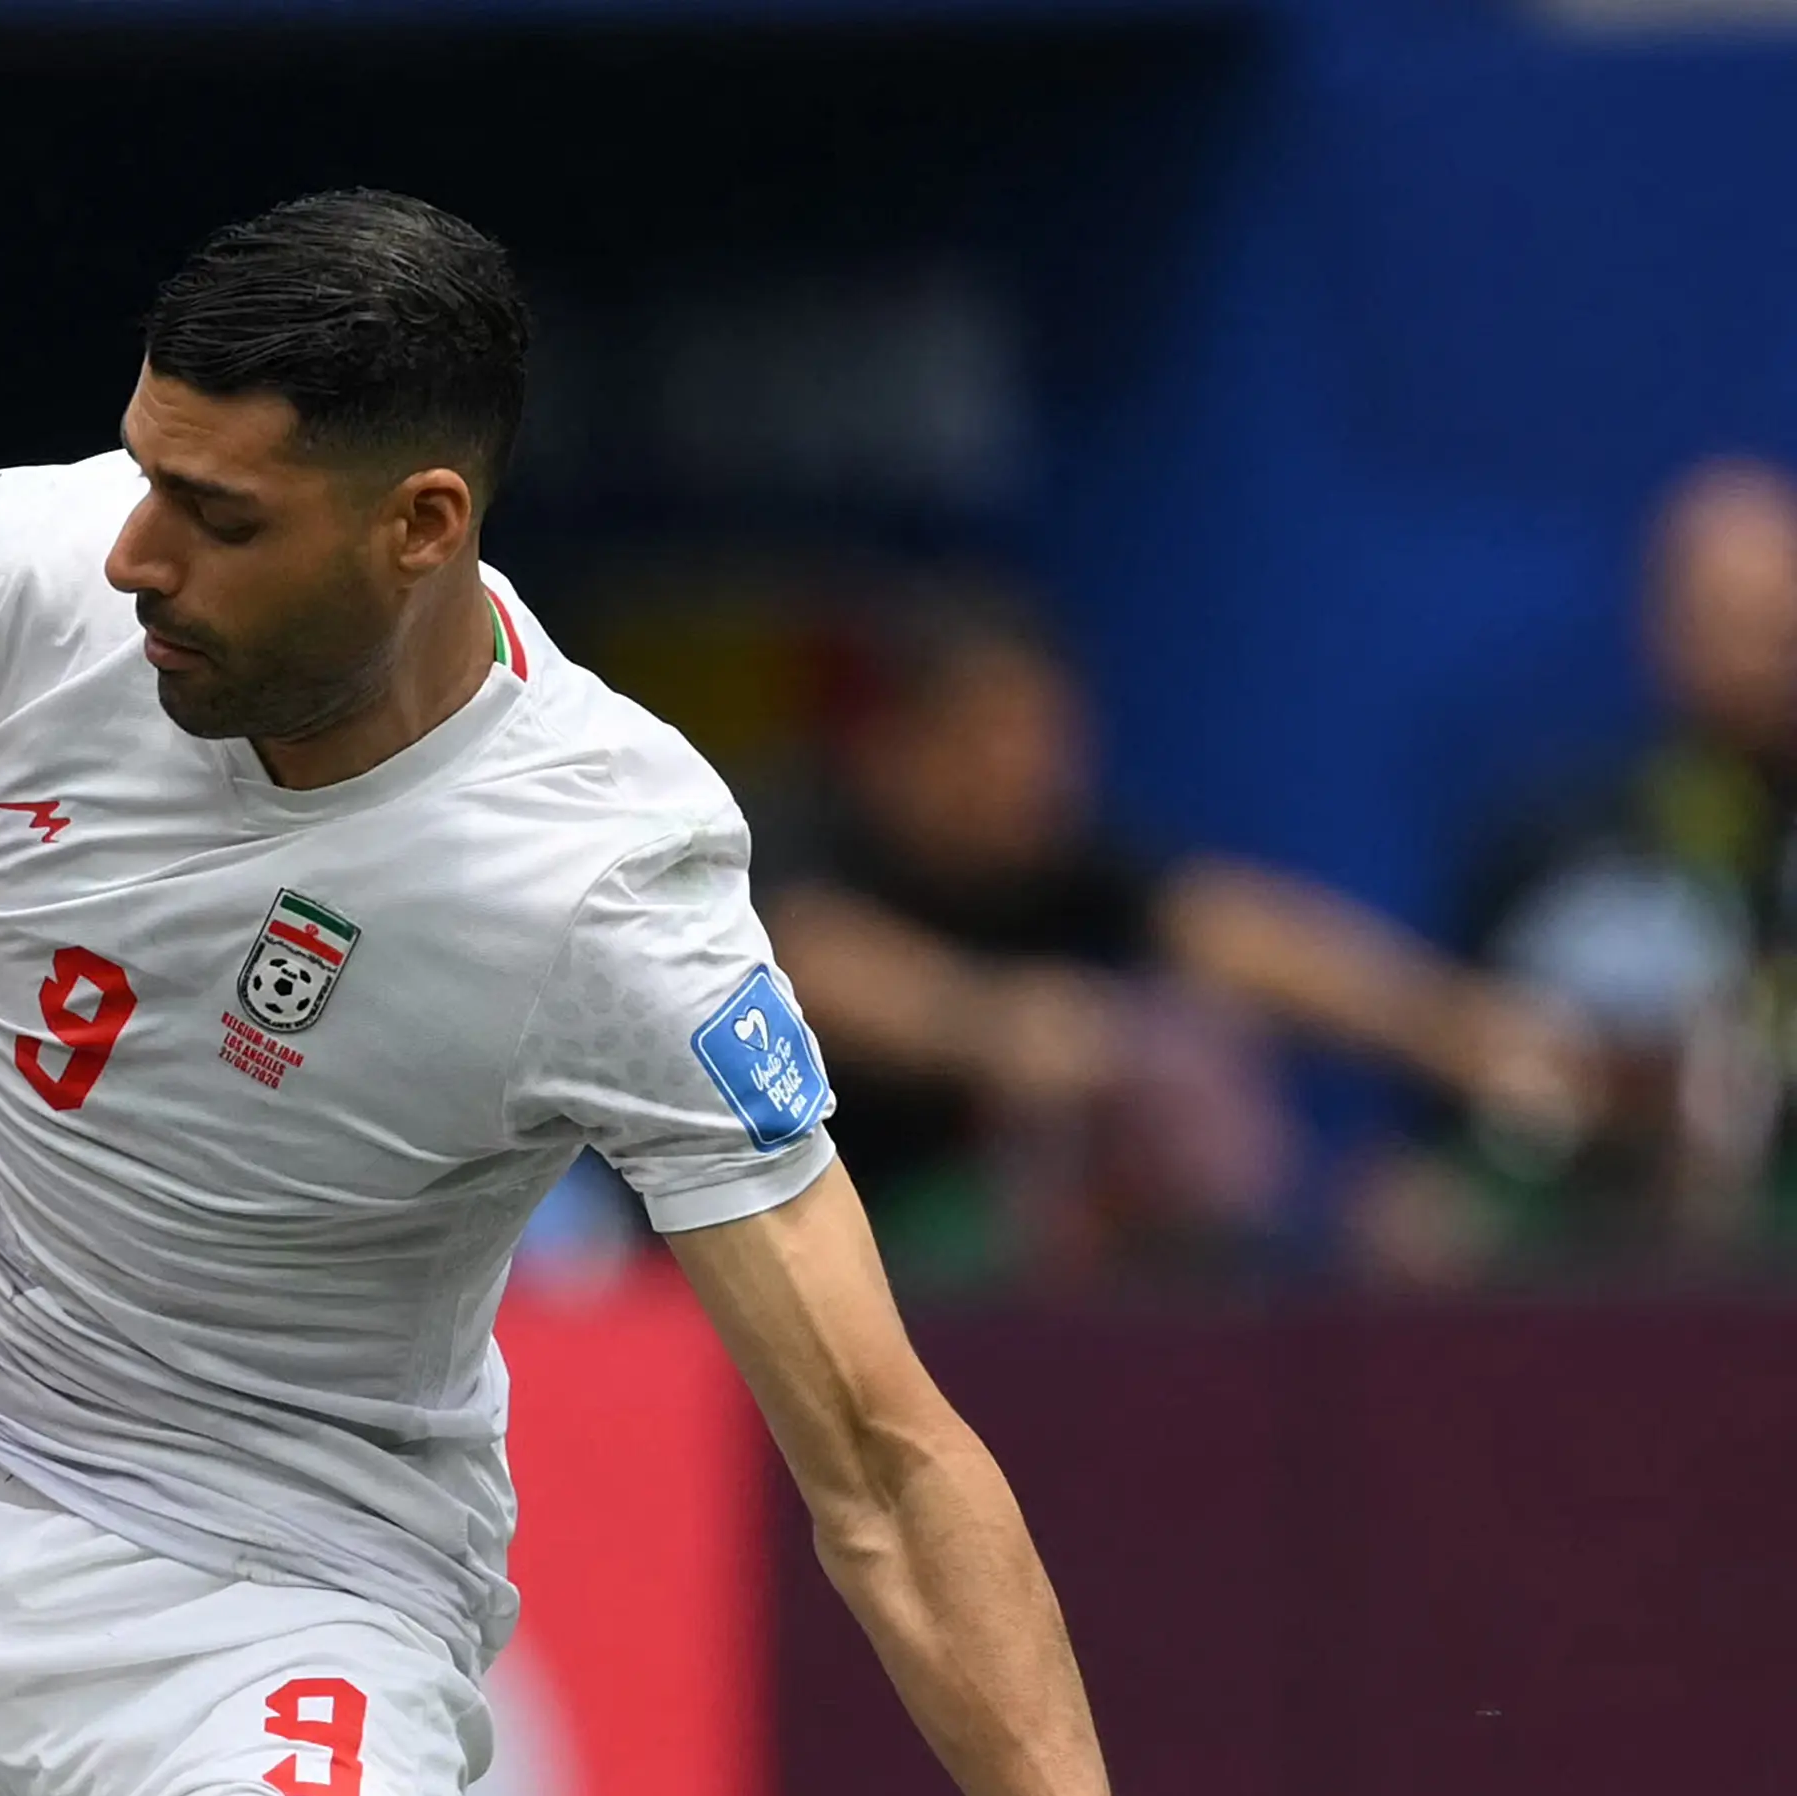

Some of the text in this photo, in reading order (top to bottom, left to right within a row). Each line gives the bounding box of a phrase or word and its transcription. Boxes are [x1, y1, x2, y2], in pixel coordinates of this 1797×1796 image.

[14, 944, 138, 1111] 9
[224, 1031, 286, 1077] LOS ANGELES
[767, 1060, 803, 1112] PEACE
